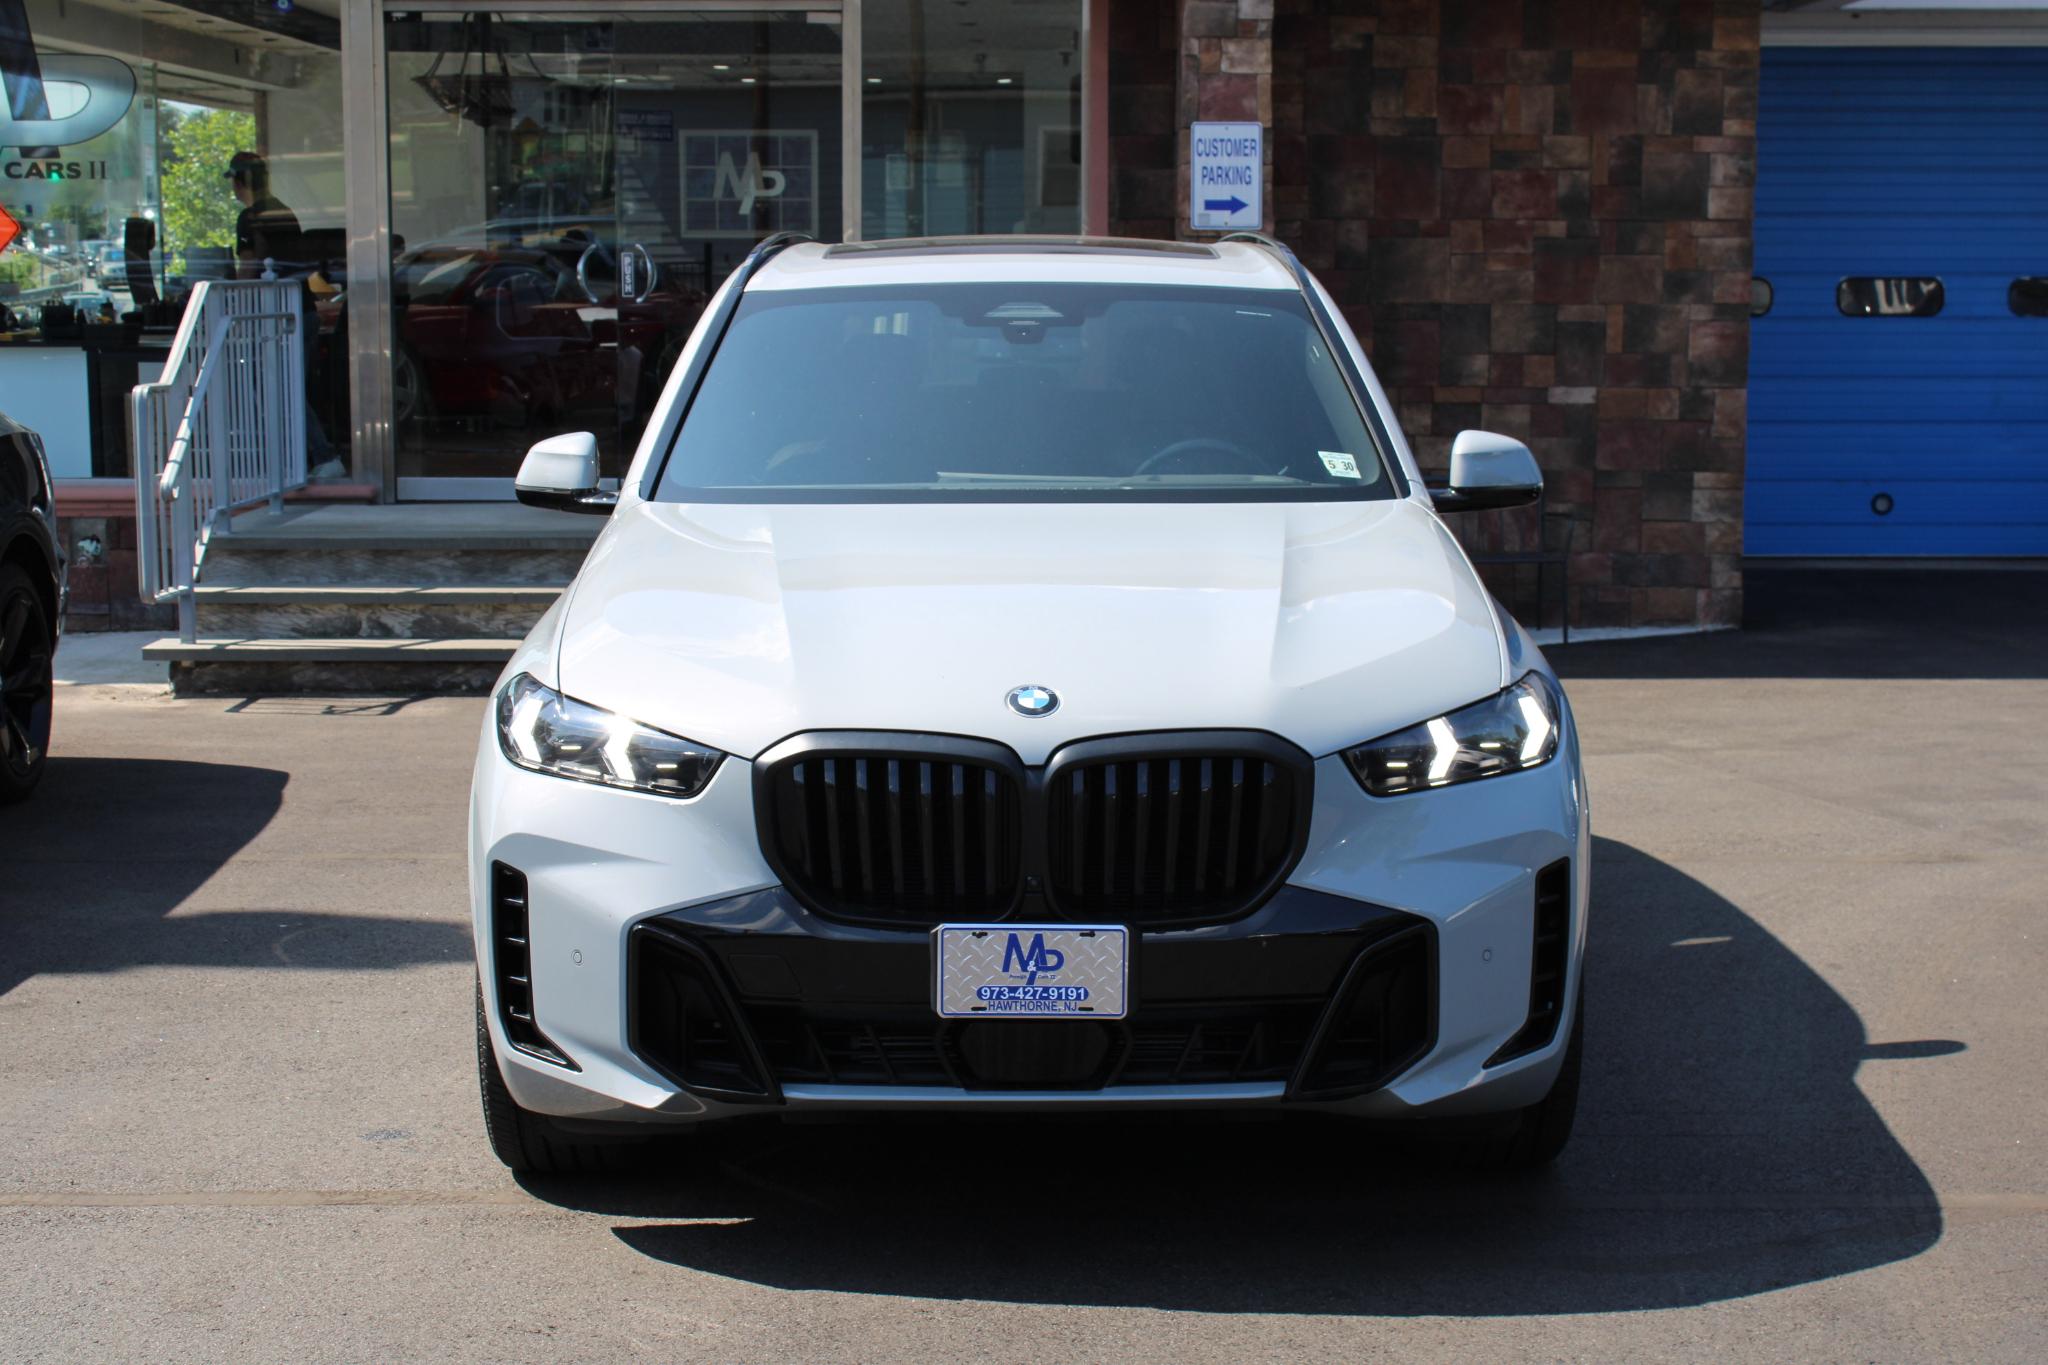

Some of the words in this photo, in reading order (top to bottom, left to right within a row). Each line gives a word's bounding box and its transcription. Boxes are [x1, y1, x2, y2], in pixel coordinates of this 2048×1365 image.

[1196, 138, 1257, 157] CUSTOMER
[4, 161, 82, 180] CARS
[1201, 166, 1252, 185] PARKING
[624, 256, 632, 293] PUSH
[1341, 461, 1354, 471] 30
[981, 987, 1085, 1000] 973-427-9191
[988, 1001, 1061, 1012] HAWTHORNE,
[1064, 1001, 1077, 1011] NJ
